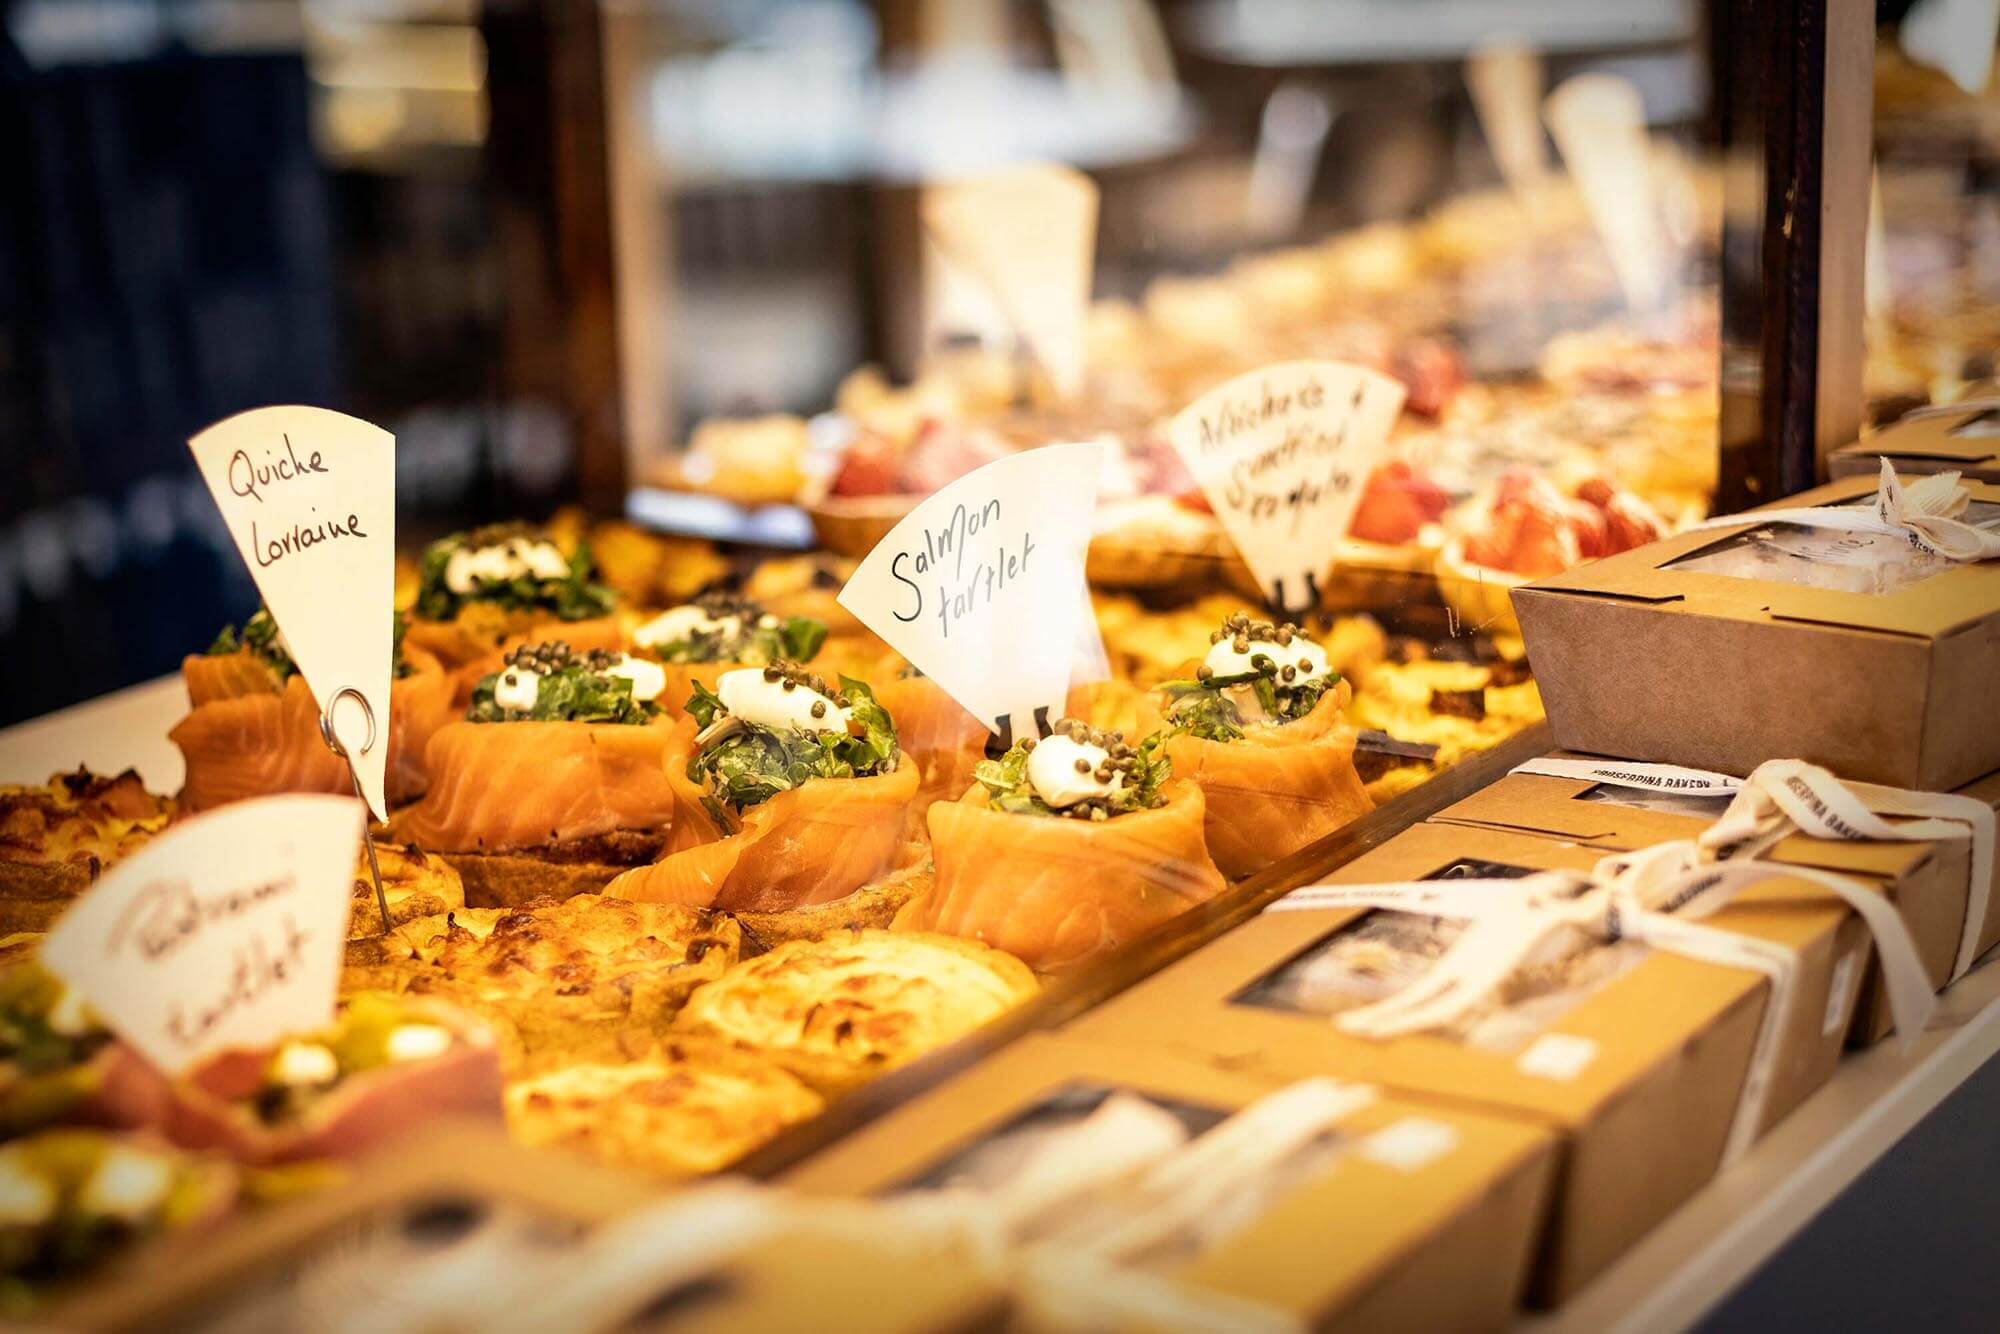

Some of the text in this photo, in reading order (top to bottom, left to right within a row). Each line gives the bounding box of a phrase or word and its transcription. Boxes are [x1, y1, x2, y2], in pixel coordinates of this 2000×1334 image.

[229, 433, 329, 503] Quiche
[891, 499, 1000, 622] Salmon
[938, 532, 1036, 638] tartlet
